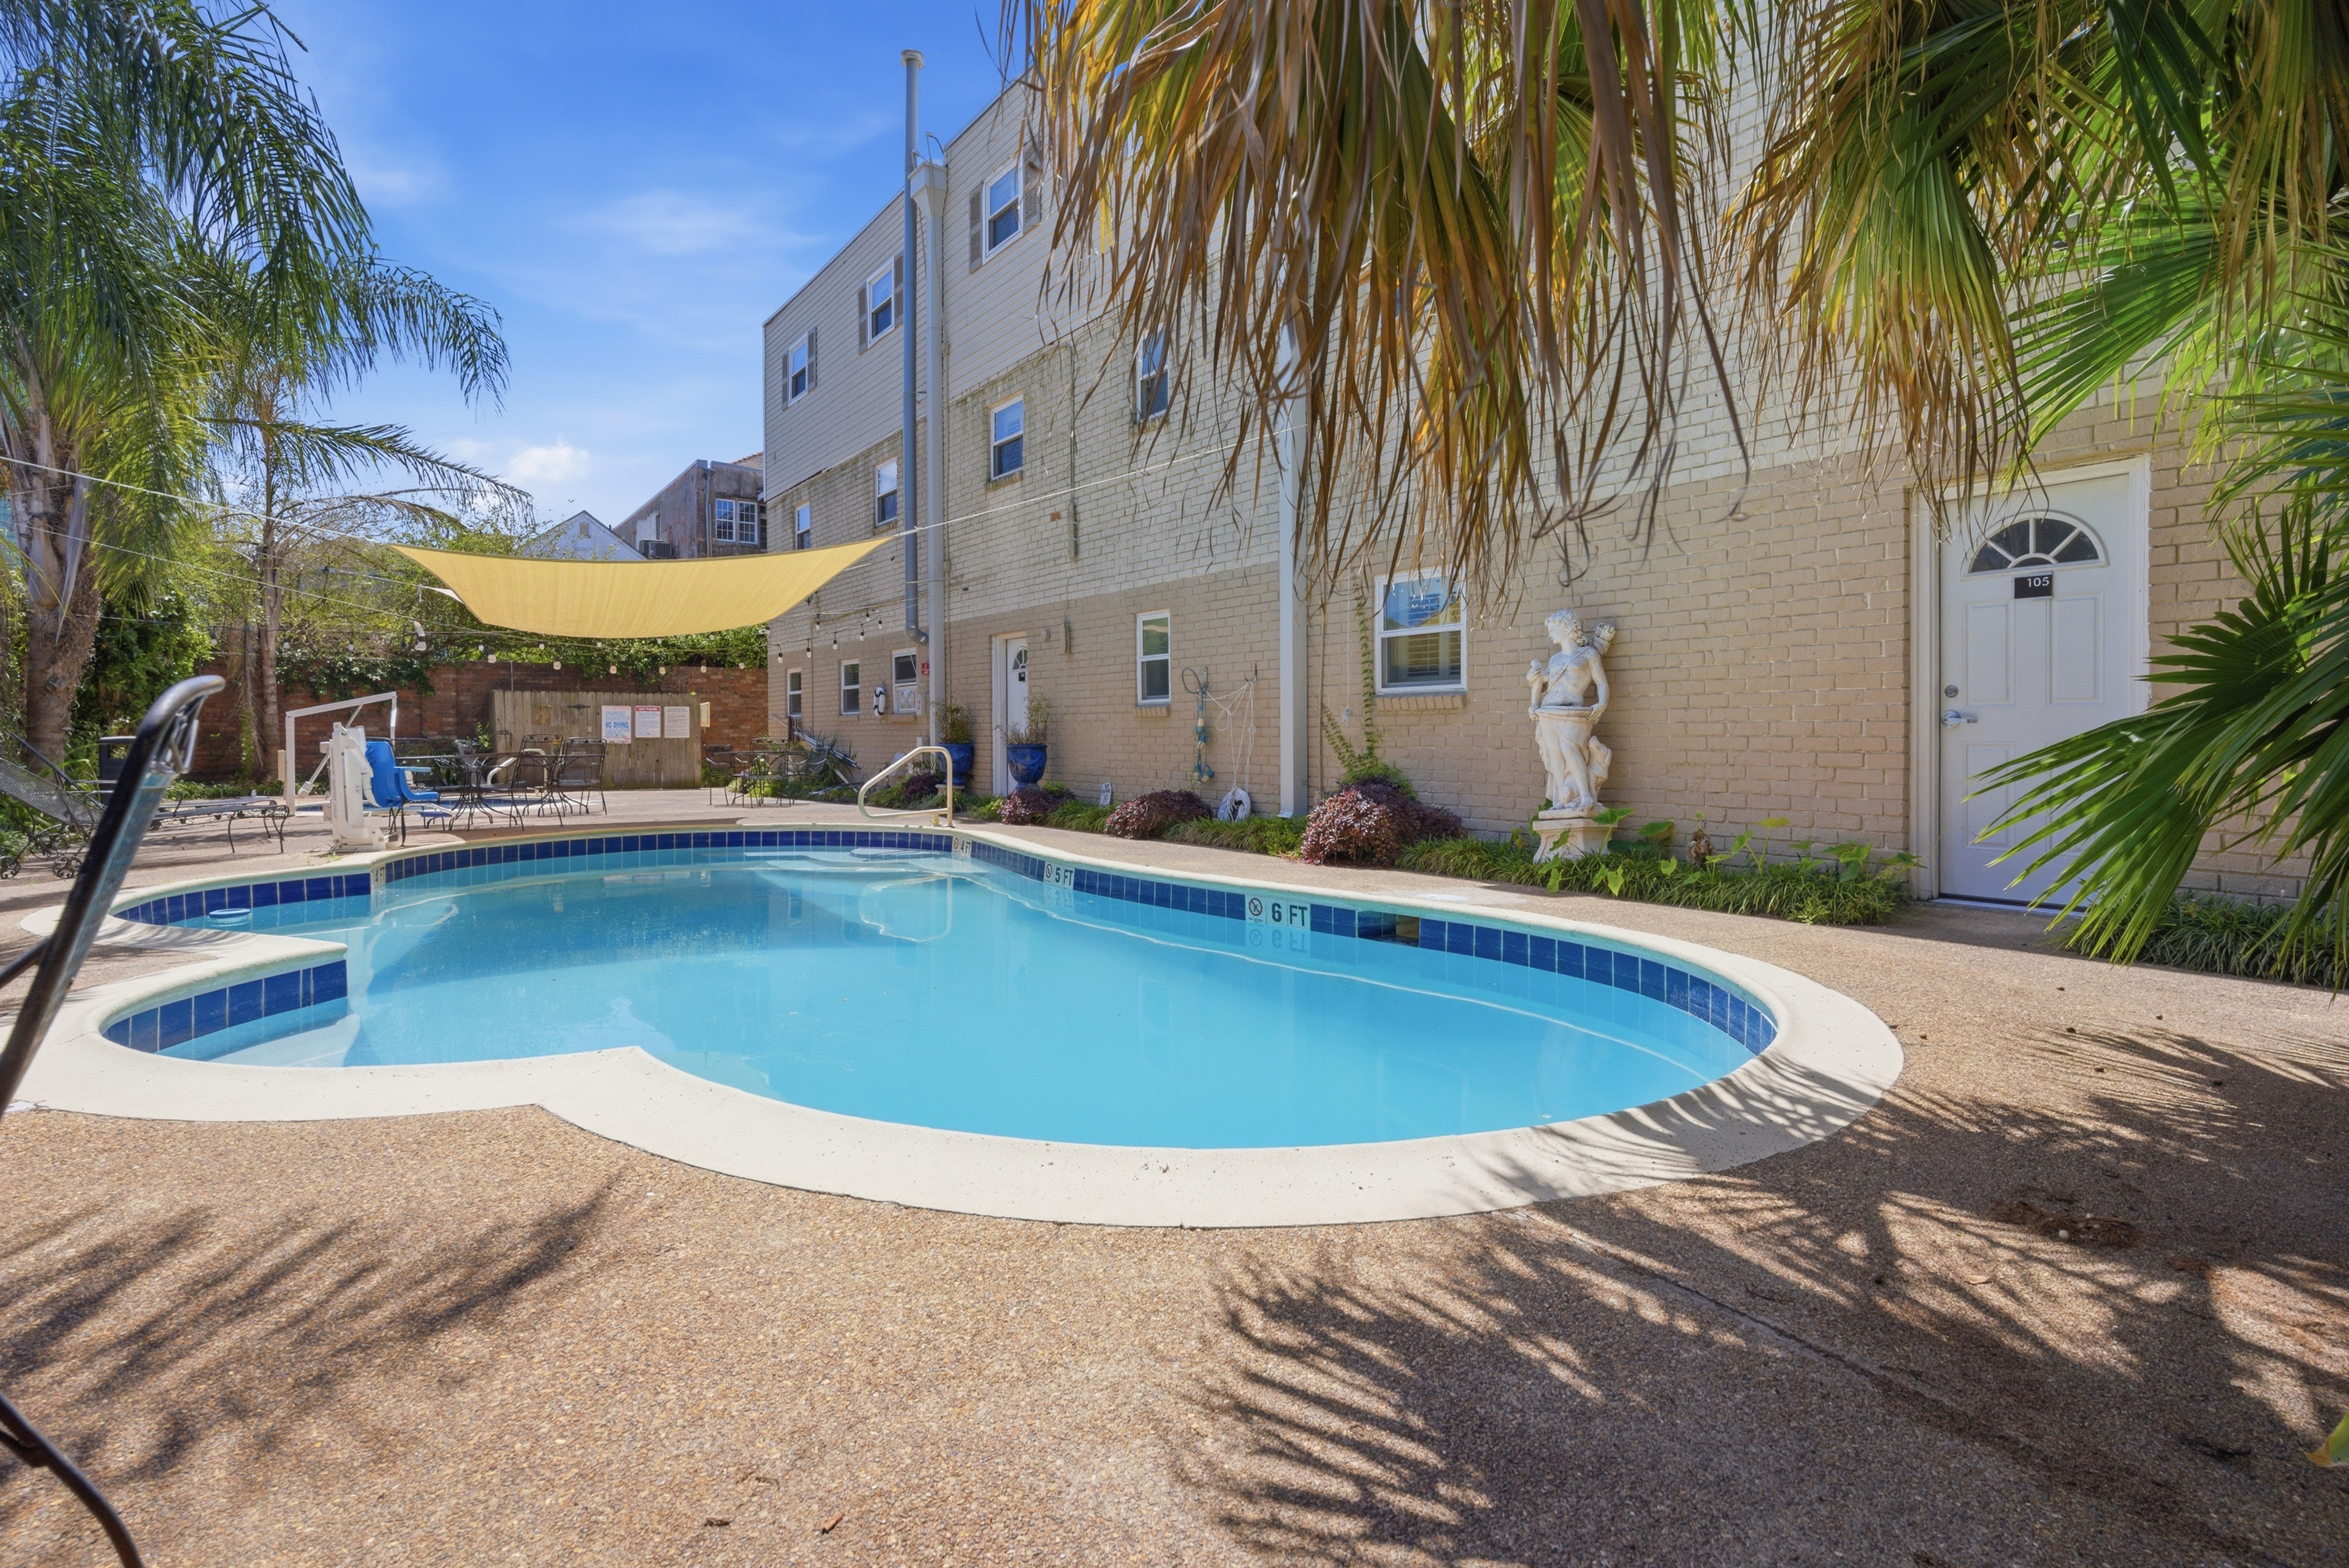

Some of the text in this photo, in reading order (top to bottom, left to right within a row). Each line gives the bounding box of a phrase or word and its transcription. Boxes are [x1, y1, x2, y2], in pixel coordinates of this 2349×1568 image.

[2027, 577, 2049, 587] 105
[961, 840, 971, 854] 4 FT
[1055, 867, 1074, 886] 5 FT
[1272, 903, 1307, 926] 6 FT
